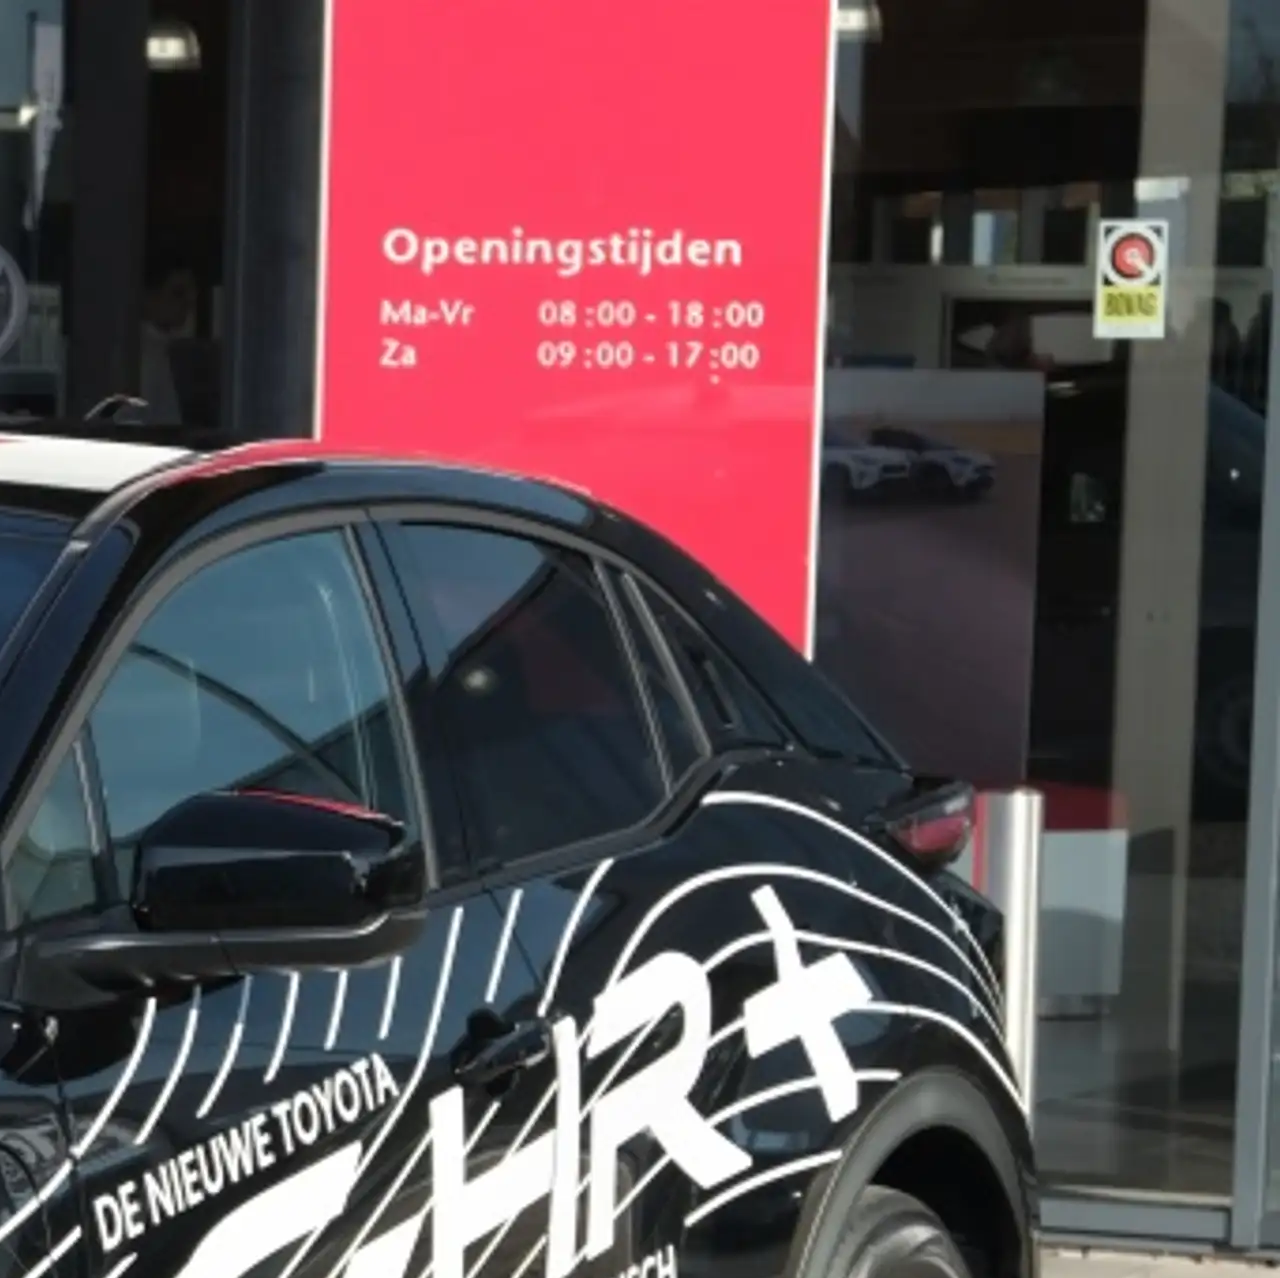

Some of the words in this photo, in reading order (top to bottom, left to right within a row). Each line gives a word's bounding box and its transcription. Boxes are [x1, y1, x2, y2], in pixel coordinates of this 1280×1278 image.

[381, 226, 743, 277] Openingstijden
[380, 299, 476, 326] Ma-Vr
[380, 338, 418, 368] Za
[94, 1181, 146, 1252] DE
[143, 1112, 277, 1225] NIEUWE
[272, 1052, 401, 1155] TOYOTA
